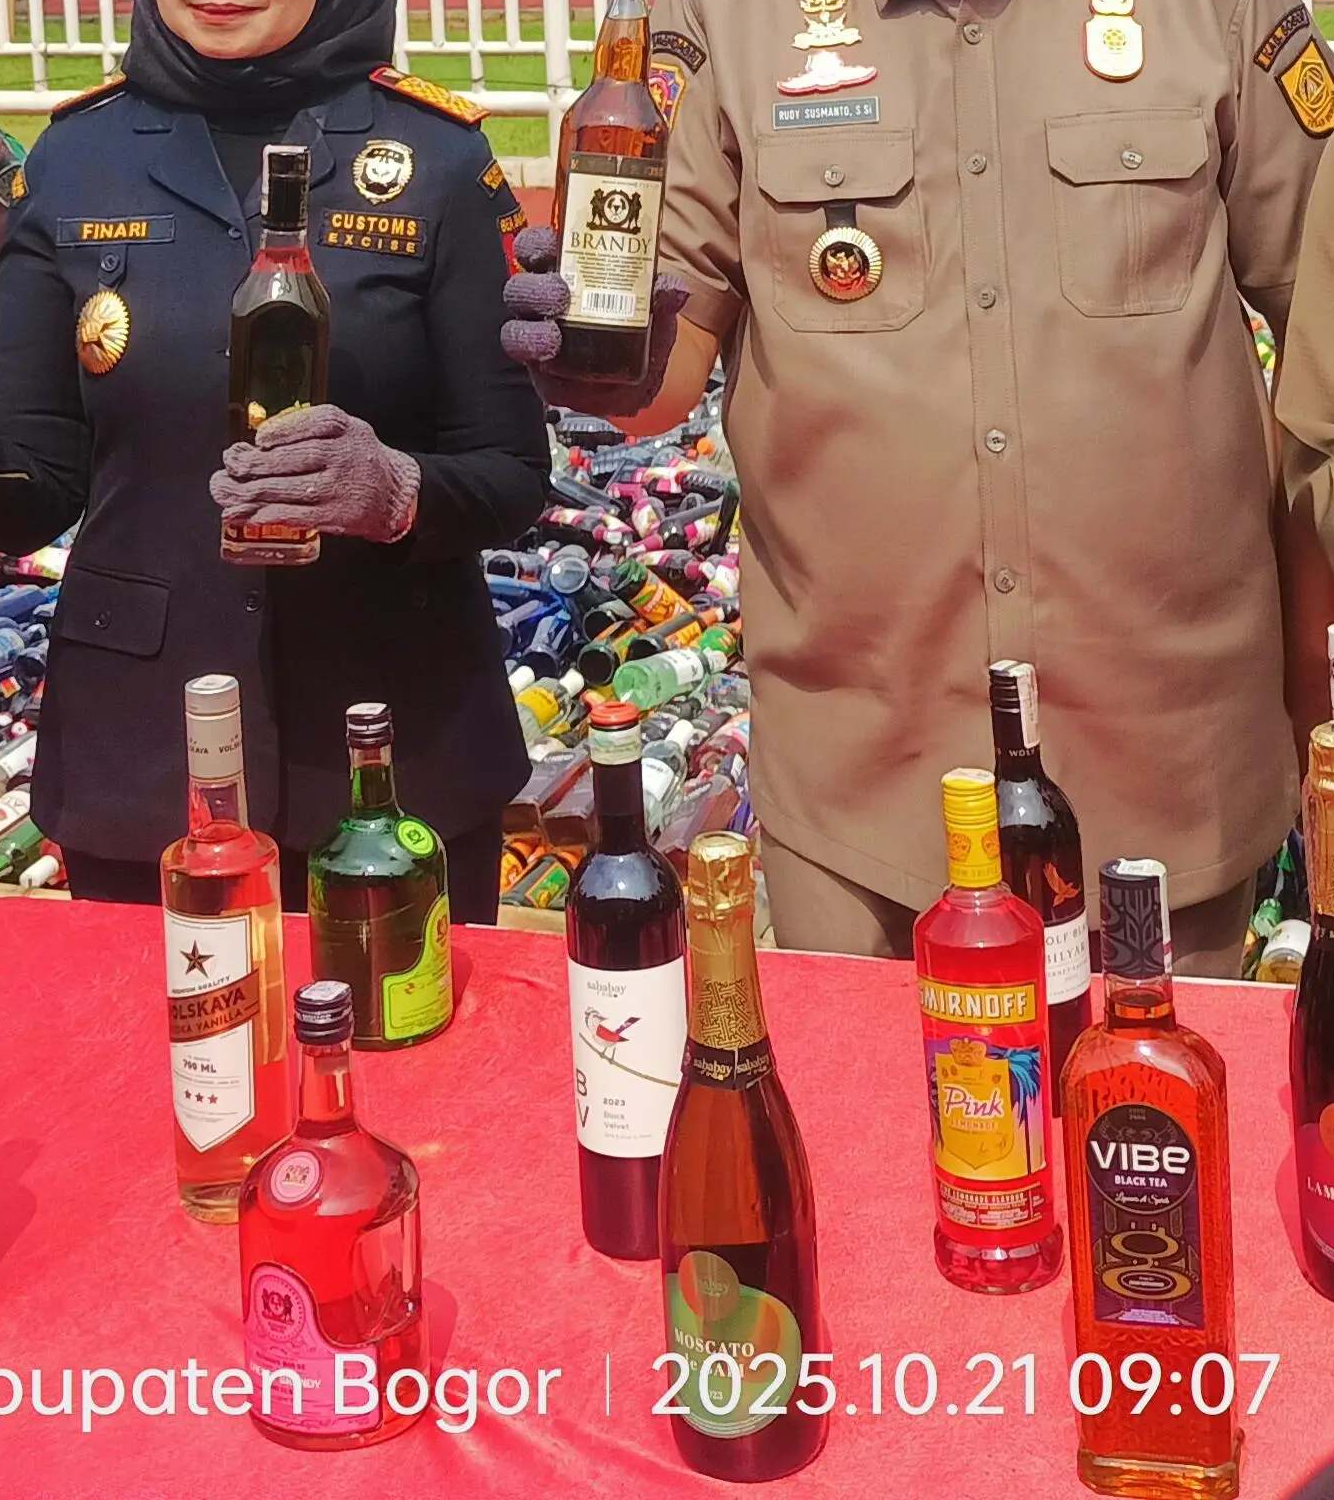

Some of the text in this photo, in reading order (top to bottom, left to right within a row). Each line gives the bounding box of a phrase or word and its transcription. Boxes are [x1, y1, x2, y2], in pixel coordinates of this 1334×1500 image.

[778, 107, 800, 121] RUDY
[81, 221, 147, 240] FINARI
[331, 213, 417, 236] CUSTOMS
[570, 231, 652, 255] BRANDY
[1045, 932, 1069, 946] OLF
[587, 980, 627, 995] sababay
[170, 988, 247, 1023] OLSKAYA
[195, 1010, 243, 1032] VANILLA
[183, 1058, 217, 1074] 700 ML
[693, 1057, 733, 1076] sababay
[575, 1068, 588, 1097] B
[602, 1097, 626, 1107] 2023
[942, 1084, 1004, 1119] Pink
[578, 1099, 590, 1128] V
[950, 1120, 998, 1131] LEMONADE
[1114, 1174, 1168, 1188] BLACK TEA
[674, 1327, 755, 1358] MOSCATO
